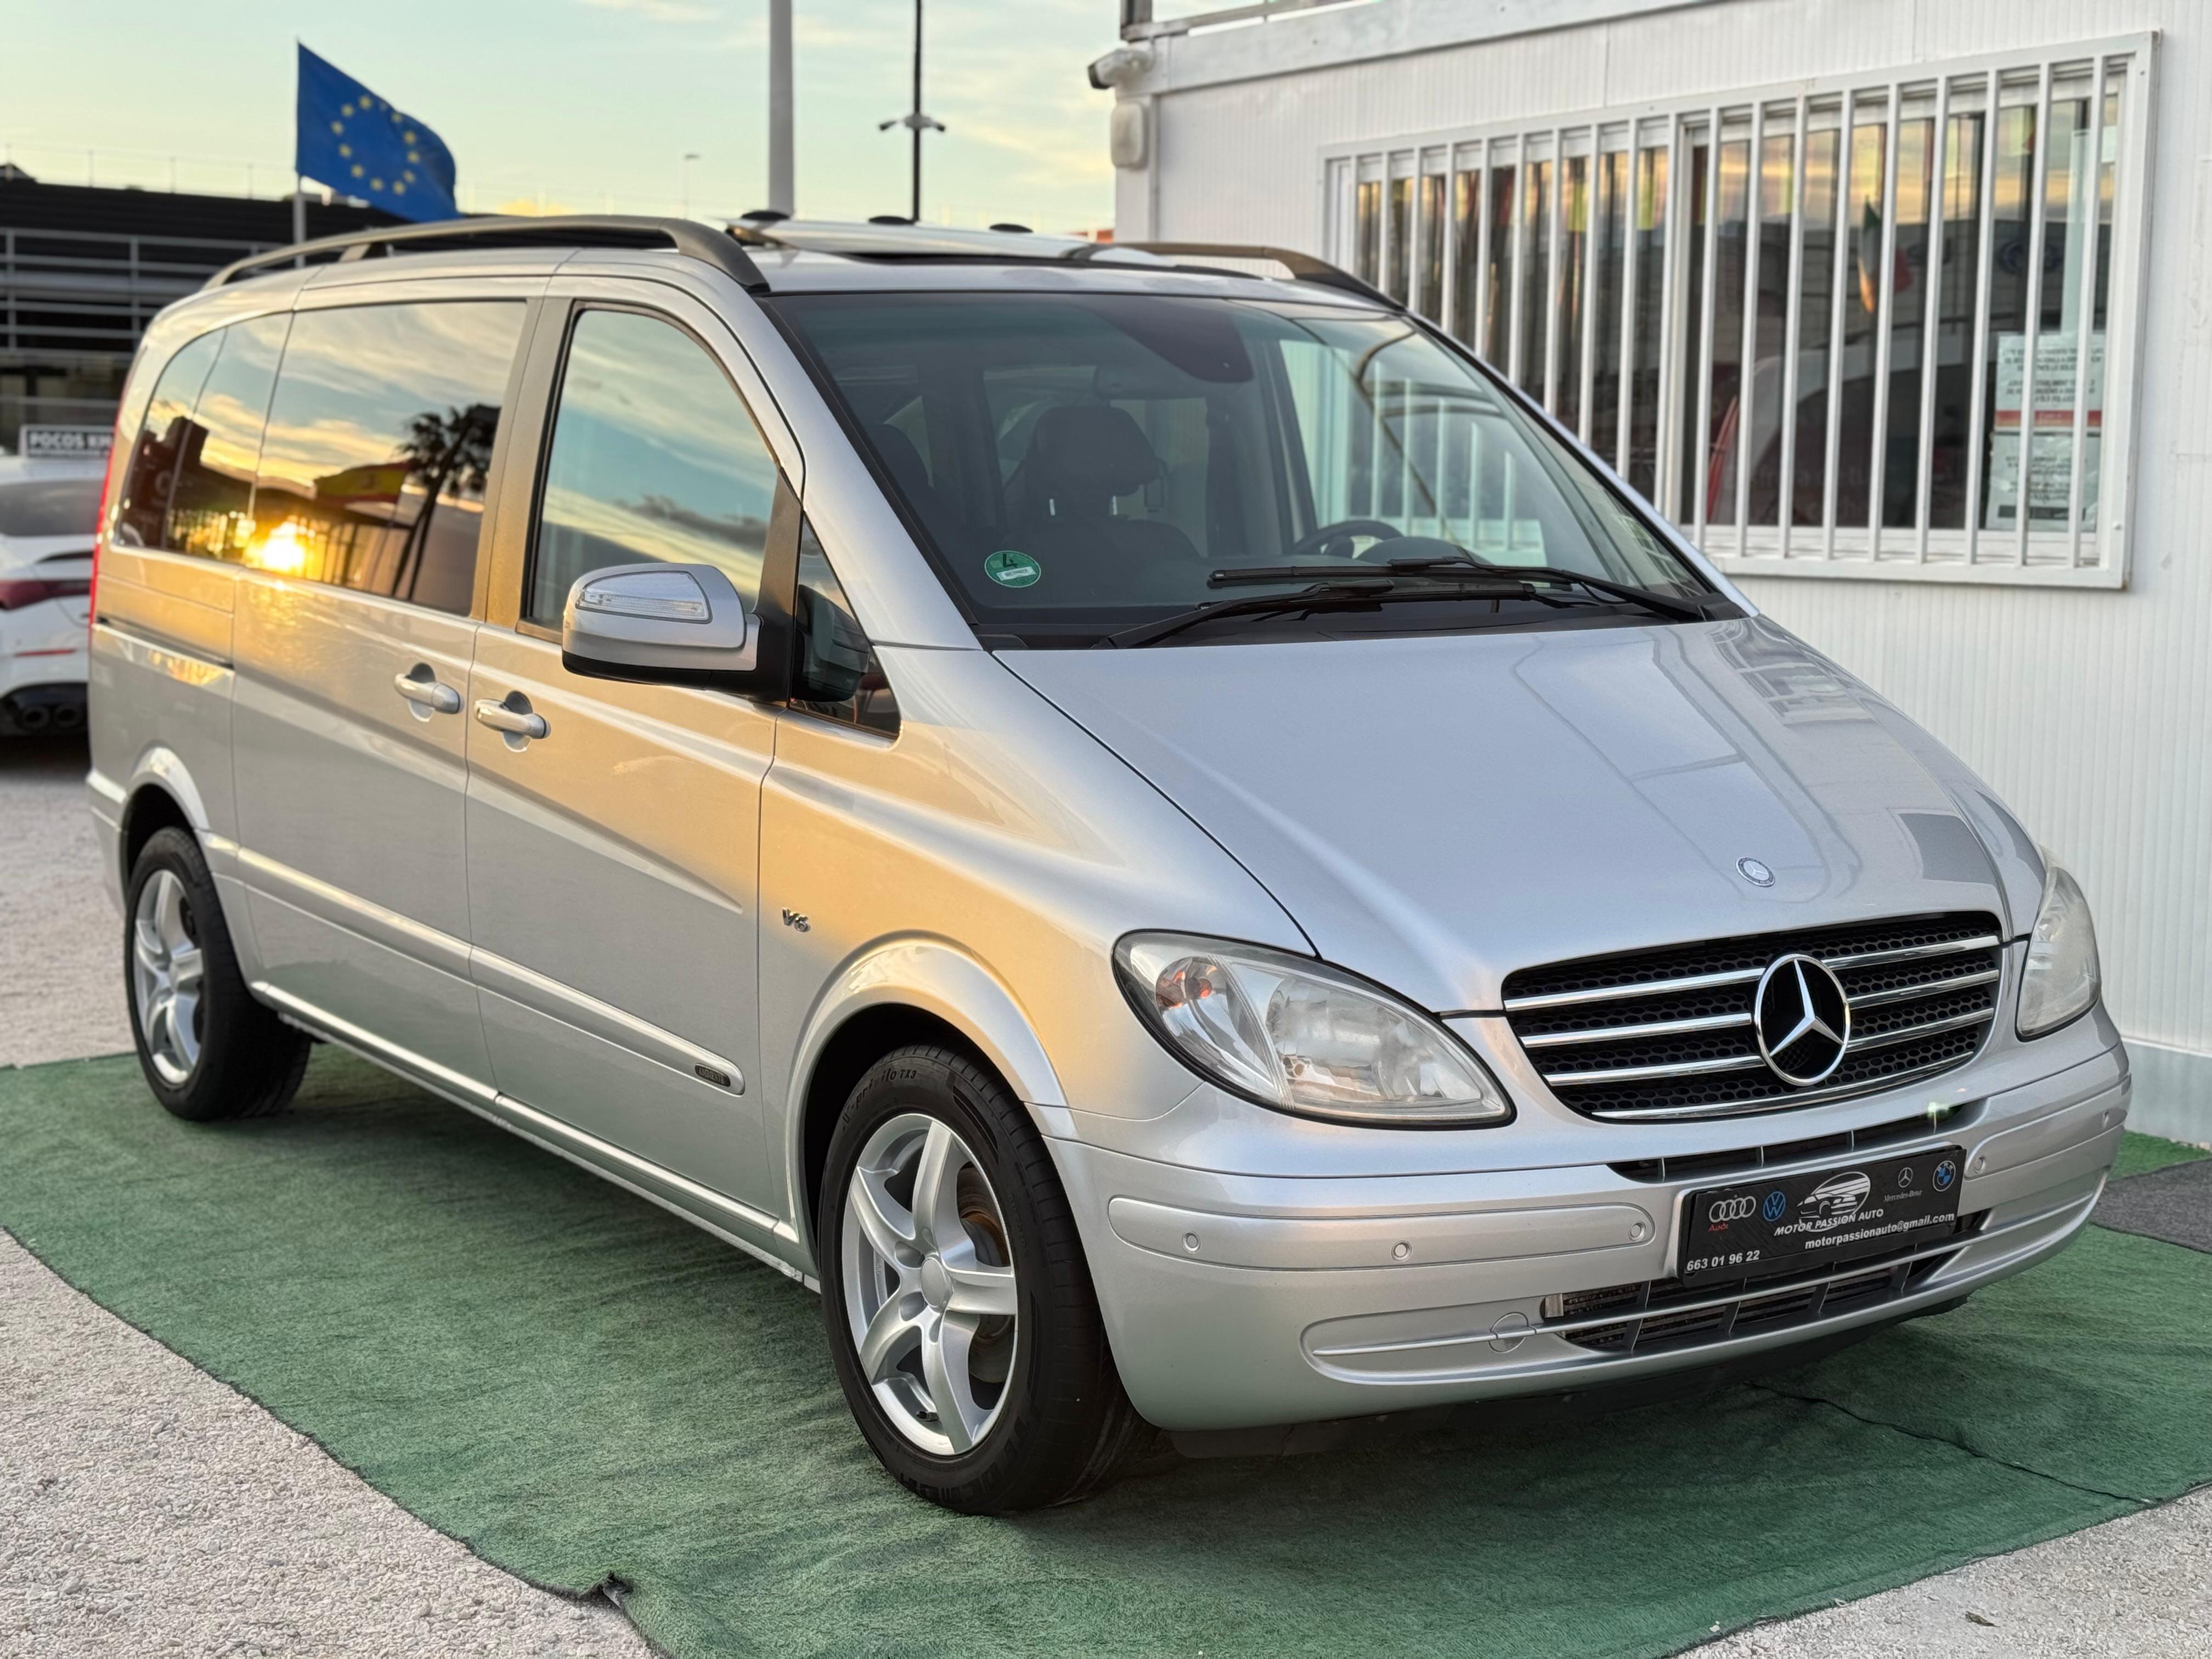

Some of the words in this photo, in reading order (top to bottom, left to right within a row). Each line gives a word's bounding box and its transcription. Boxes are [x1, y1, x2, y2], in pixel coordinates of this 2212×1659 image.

[1002, 553, 1018, 568] 4
[782, 907, 811, 933] V6
[900, 1069, 917, 1079] TX3
[1774, 1222, 1813, 1236] MOTOR
[1815, 1213, 1856, 1229] PASSION
[1858, 1209, 1884, 1221] AUTO
[1805, 1212, 1955, 1249] motorpassionauto@gmail.com
[1686, 1258, 1708, 1271] 663
[1711, 1255, 1725, 1267] 01
[1729, 1252, 1743, 1264] 96
[1746, 1250, 1760, 1261] 22
